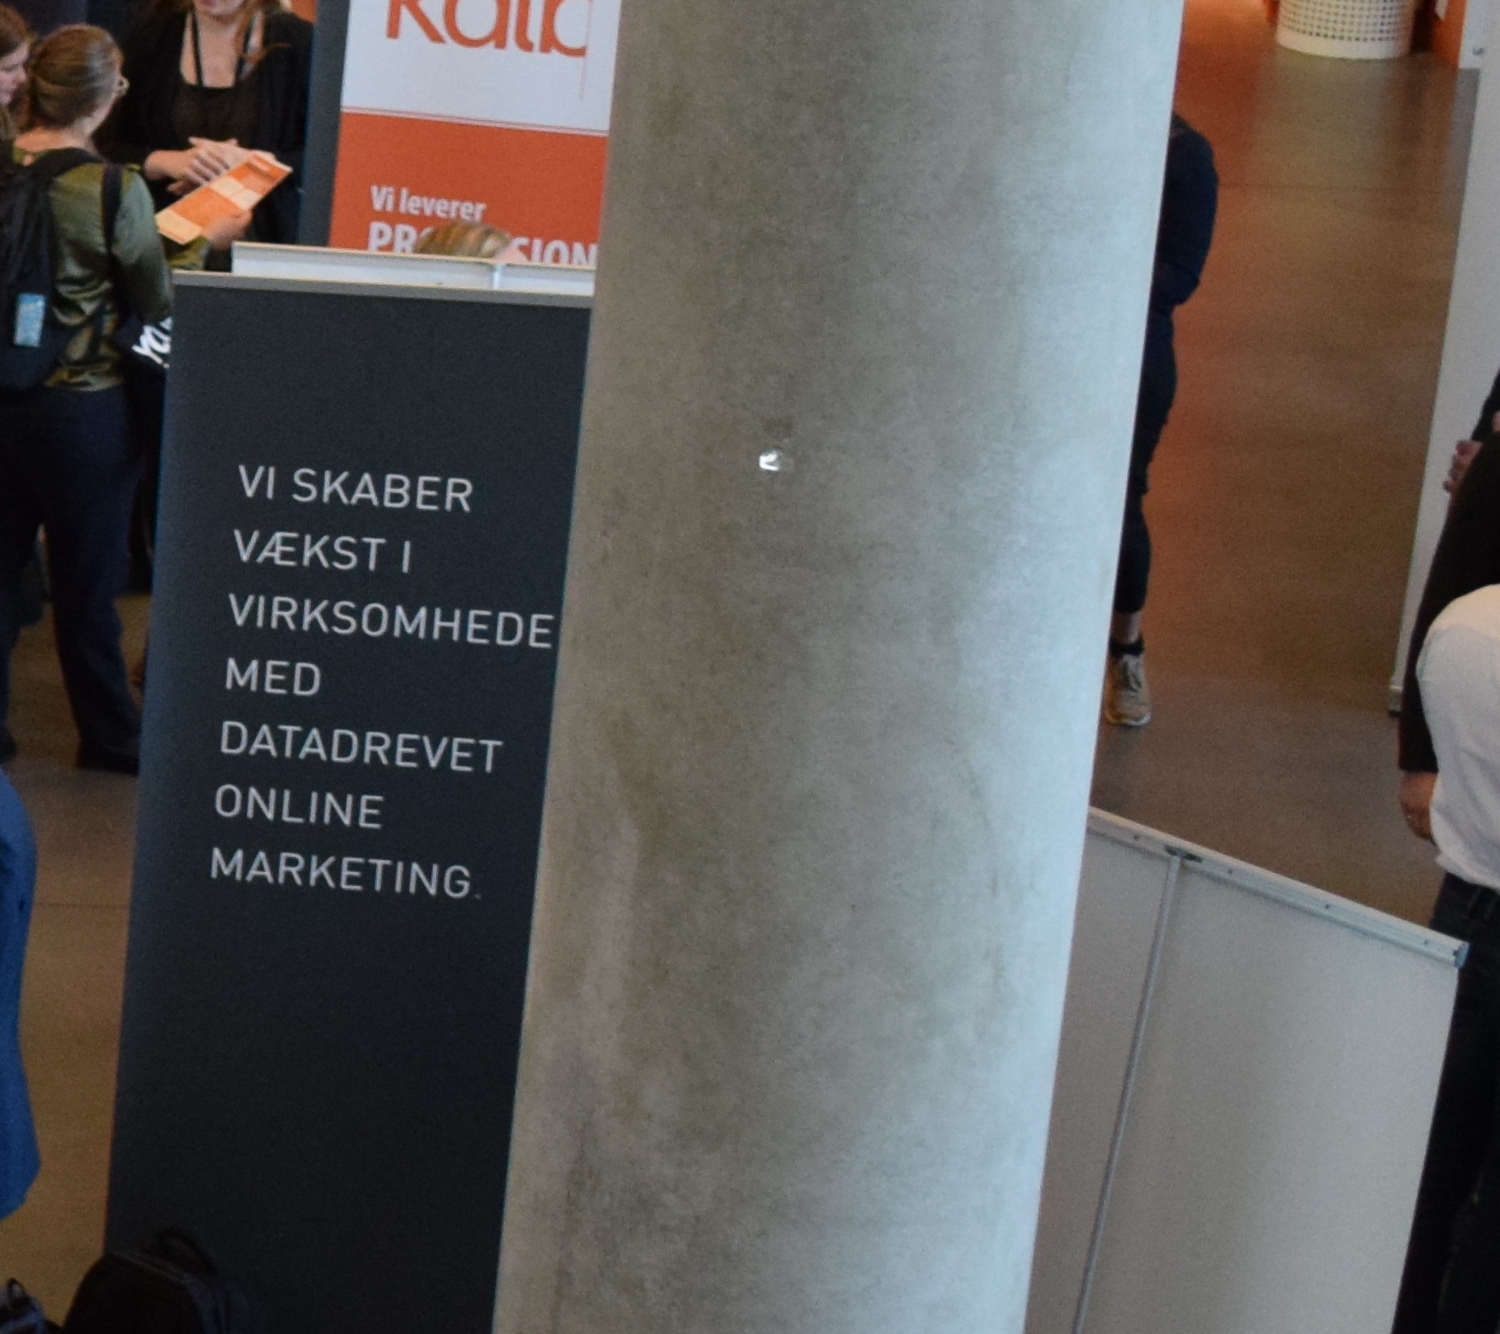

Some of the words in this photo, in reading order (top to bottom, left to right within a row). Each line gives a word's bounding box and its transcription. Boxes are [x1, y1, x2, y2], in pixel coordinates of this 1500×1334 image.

[370, 184, 395, 212] Vi
[400, 187, 487, 224] leverer
[237, 464, 276, 500] VI
[291, 467, 474, 513] SKABER
[233, 528, 387, 572] VÆKST
[401, 540, 412, 574] I
[228, 592, 556, 650] VIRKSOMHEDE
[224, 657, 322, 698] MED
[219, 720, 504, 774] DATADREVET
[214, 783, 385, 830] ONLINE
